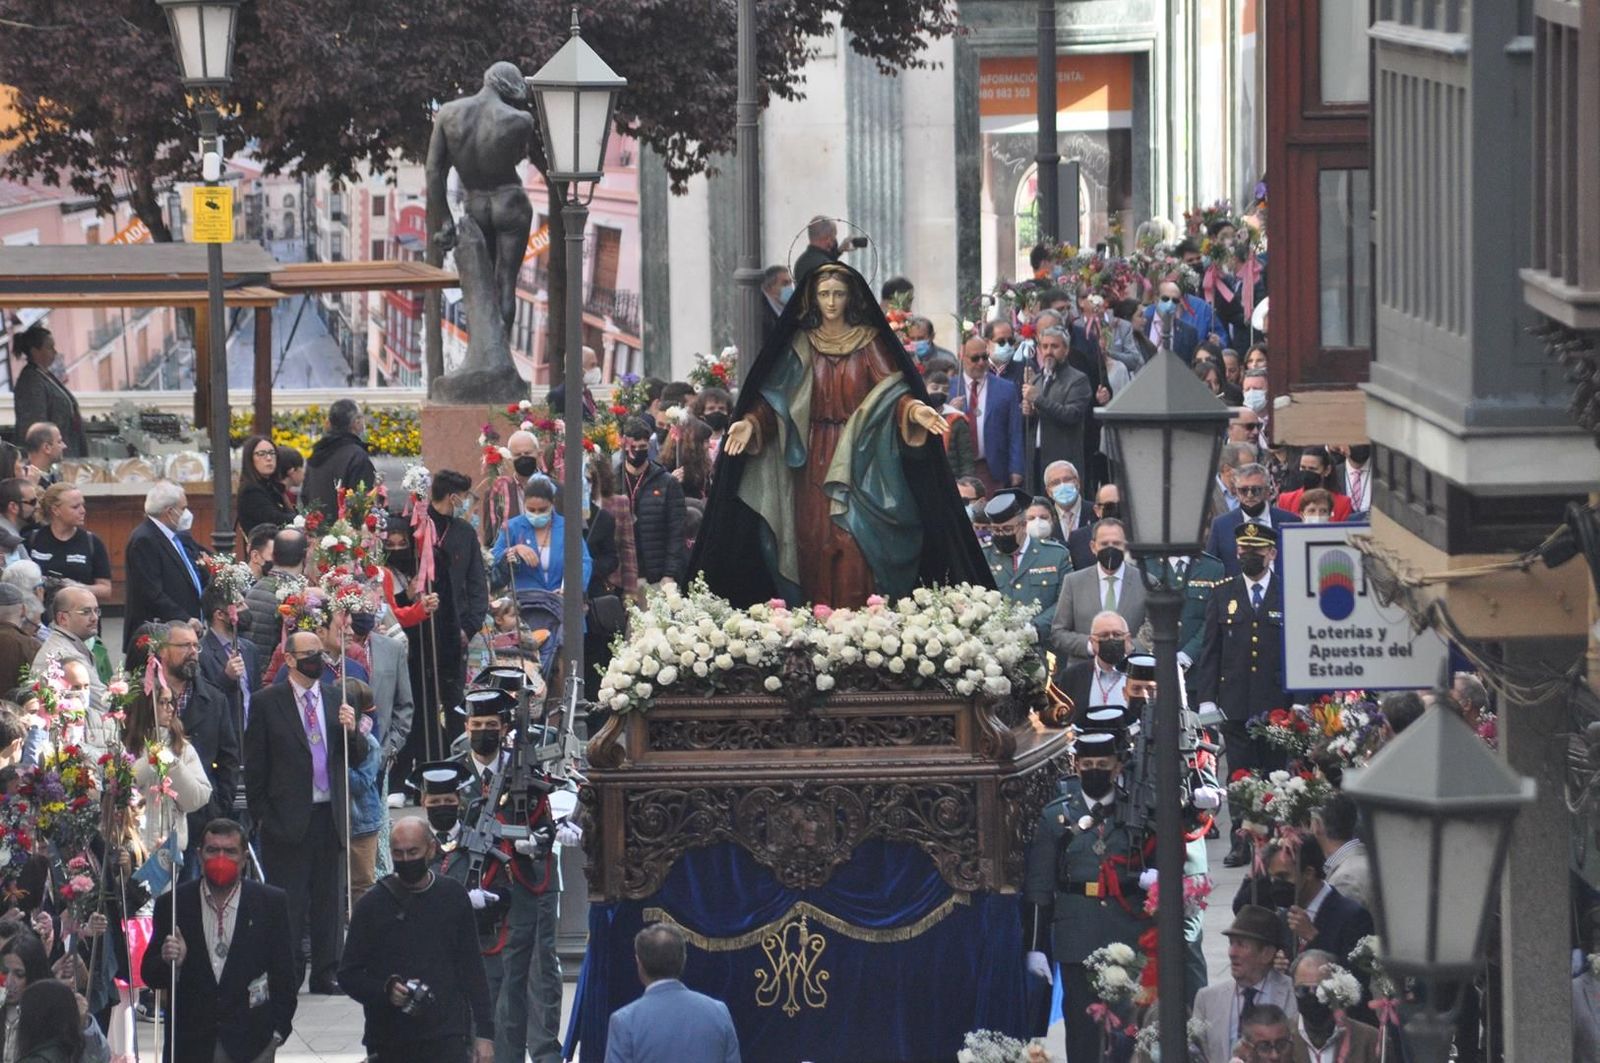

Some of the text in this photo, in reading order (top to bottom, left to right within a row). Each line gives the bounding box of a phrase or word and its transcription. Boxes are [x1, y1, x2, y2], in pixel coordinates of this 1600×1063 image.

[979, 72, 1038, 85] NFORMACIÓ
[1378, 627, 1388, 642] y
[1309, 642, 1413, 661] Apuestas del
[1309, 662, 1364, 677] Estado
